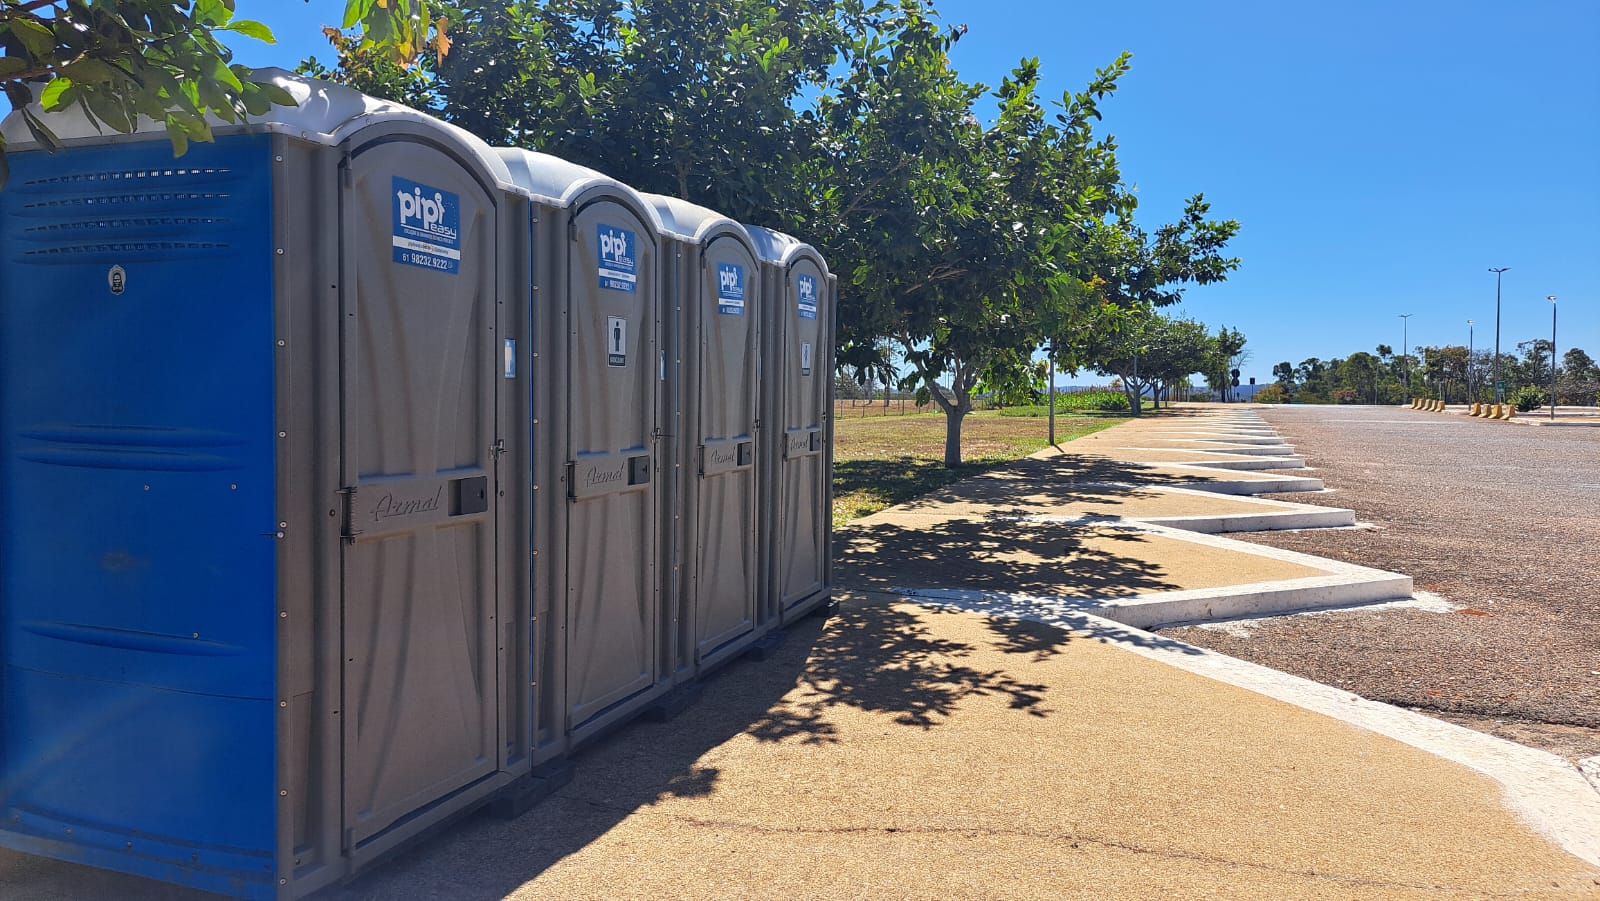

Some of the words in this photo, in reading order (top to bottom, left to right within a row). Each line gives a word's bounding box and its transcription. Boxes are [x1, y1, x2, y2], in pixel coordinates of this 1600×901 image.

[430, 224, 457, 239] easy
[402, 253, 410, 262] 61
[584, 460, 625, 488] Armal
[370, 485, 442, 521] Armal
